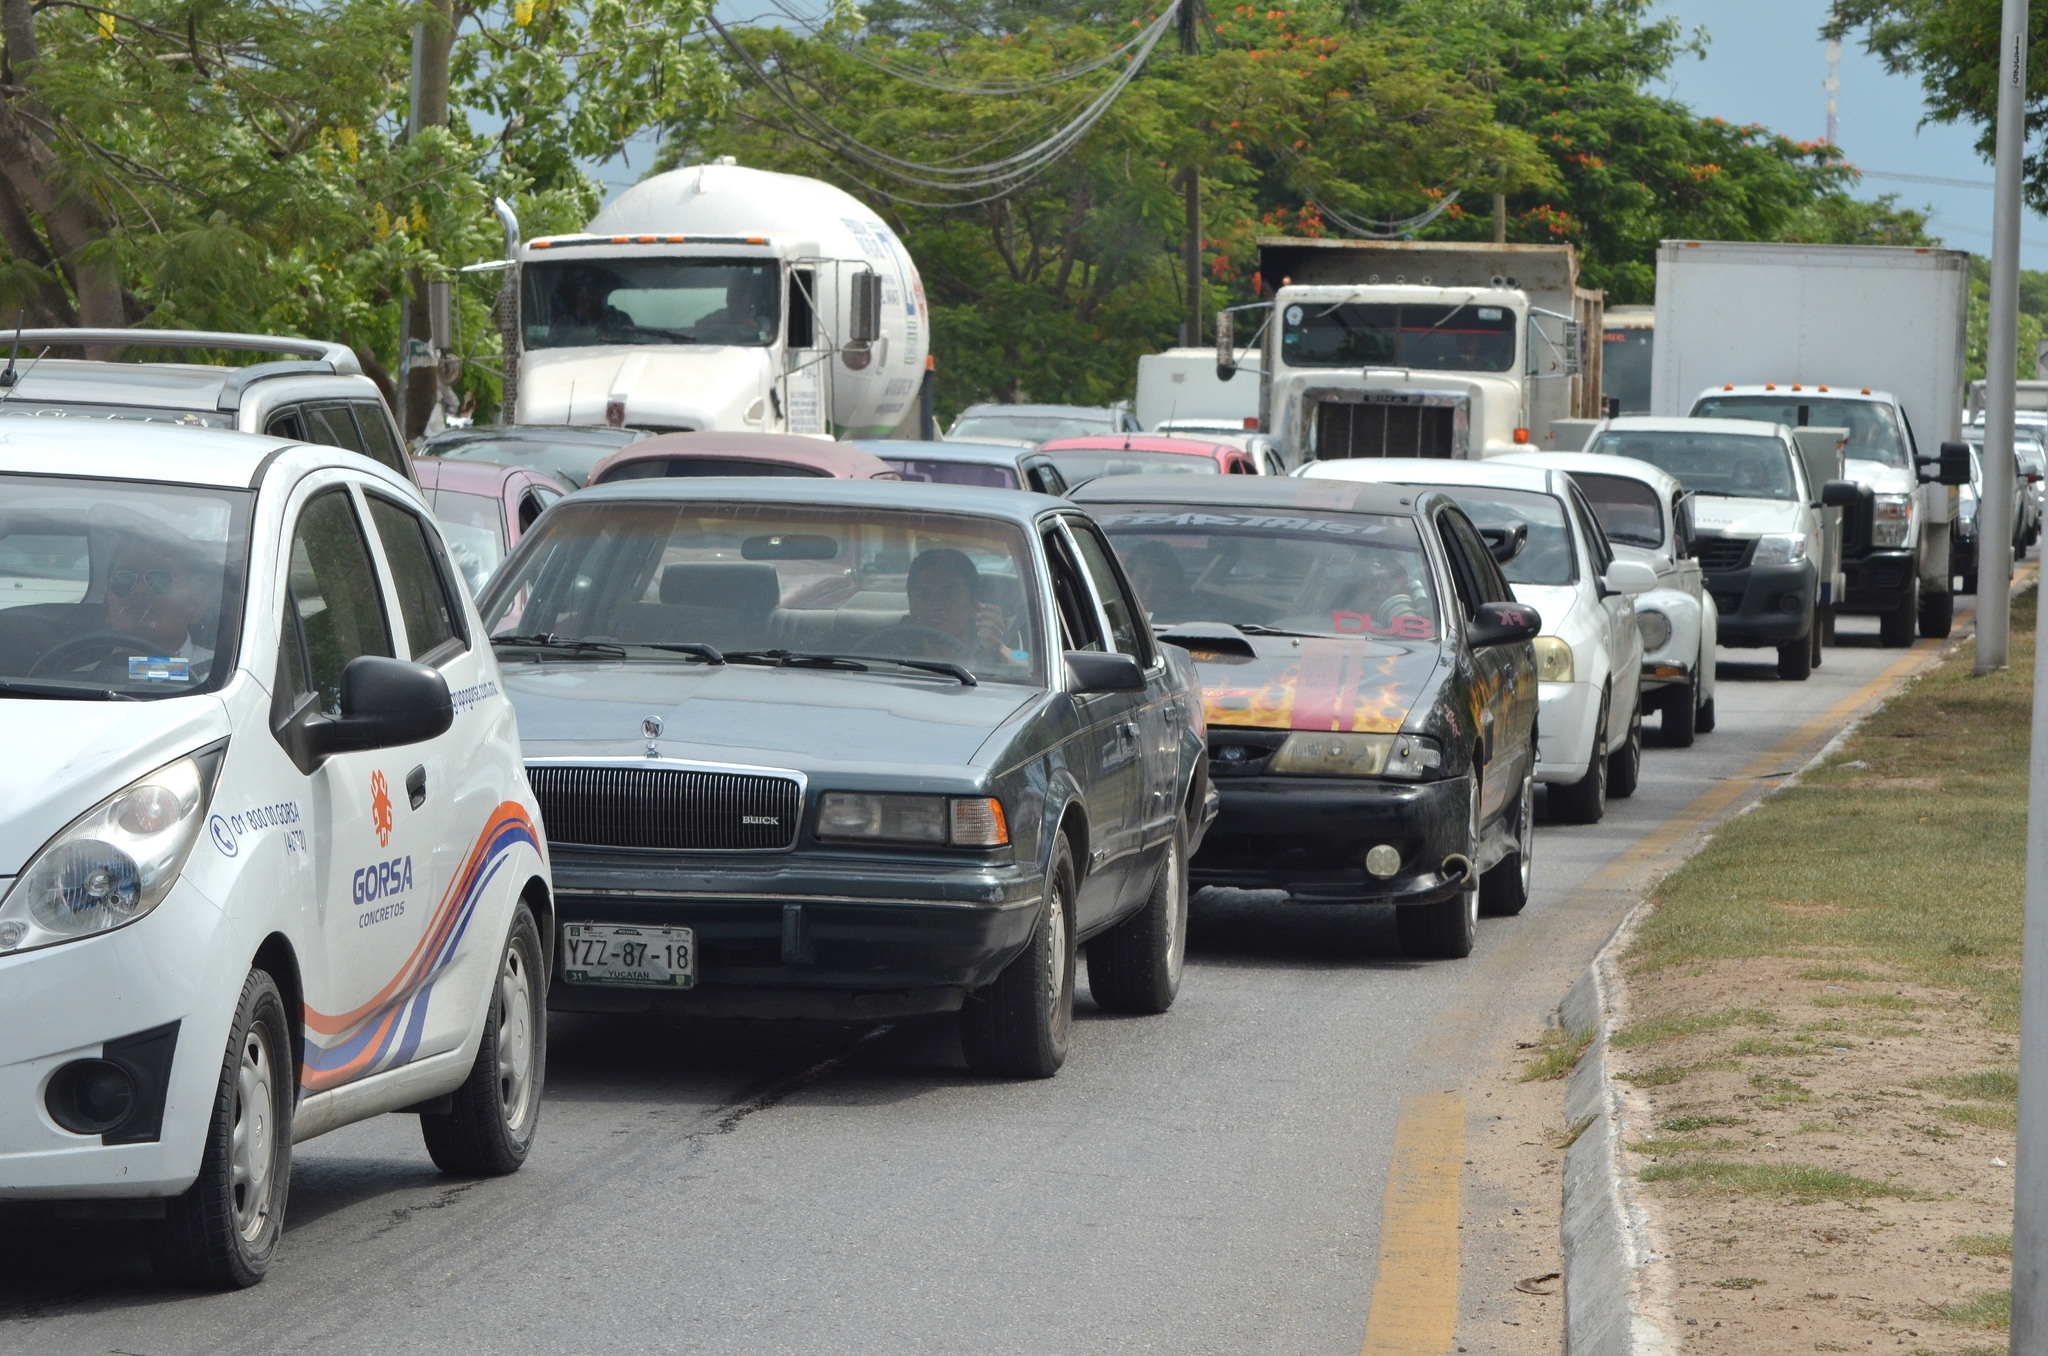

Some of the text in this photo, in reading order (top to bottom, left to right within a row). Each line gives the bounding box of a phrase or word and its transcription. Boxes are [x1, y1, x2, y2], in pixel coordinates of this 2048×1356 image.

[1332, 611, 1432, 638] DUB
[231, 814, 248, 835] 01
[246, 808, 268, 830] 800
[276, 801, 300, 824] GORSA
[742, 816, 779, 825] BUICK
[353, 855, 412, 905] GORSA
[359, 900, 405, 928] CONCRETOS
[568, 939, 688, 969] YZZ-87-18
[571, 972, 582, 981] 31
[608, 970, 650, 979] YUCATAN
